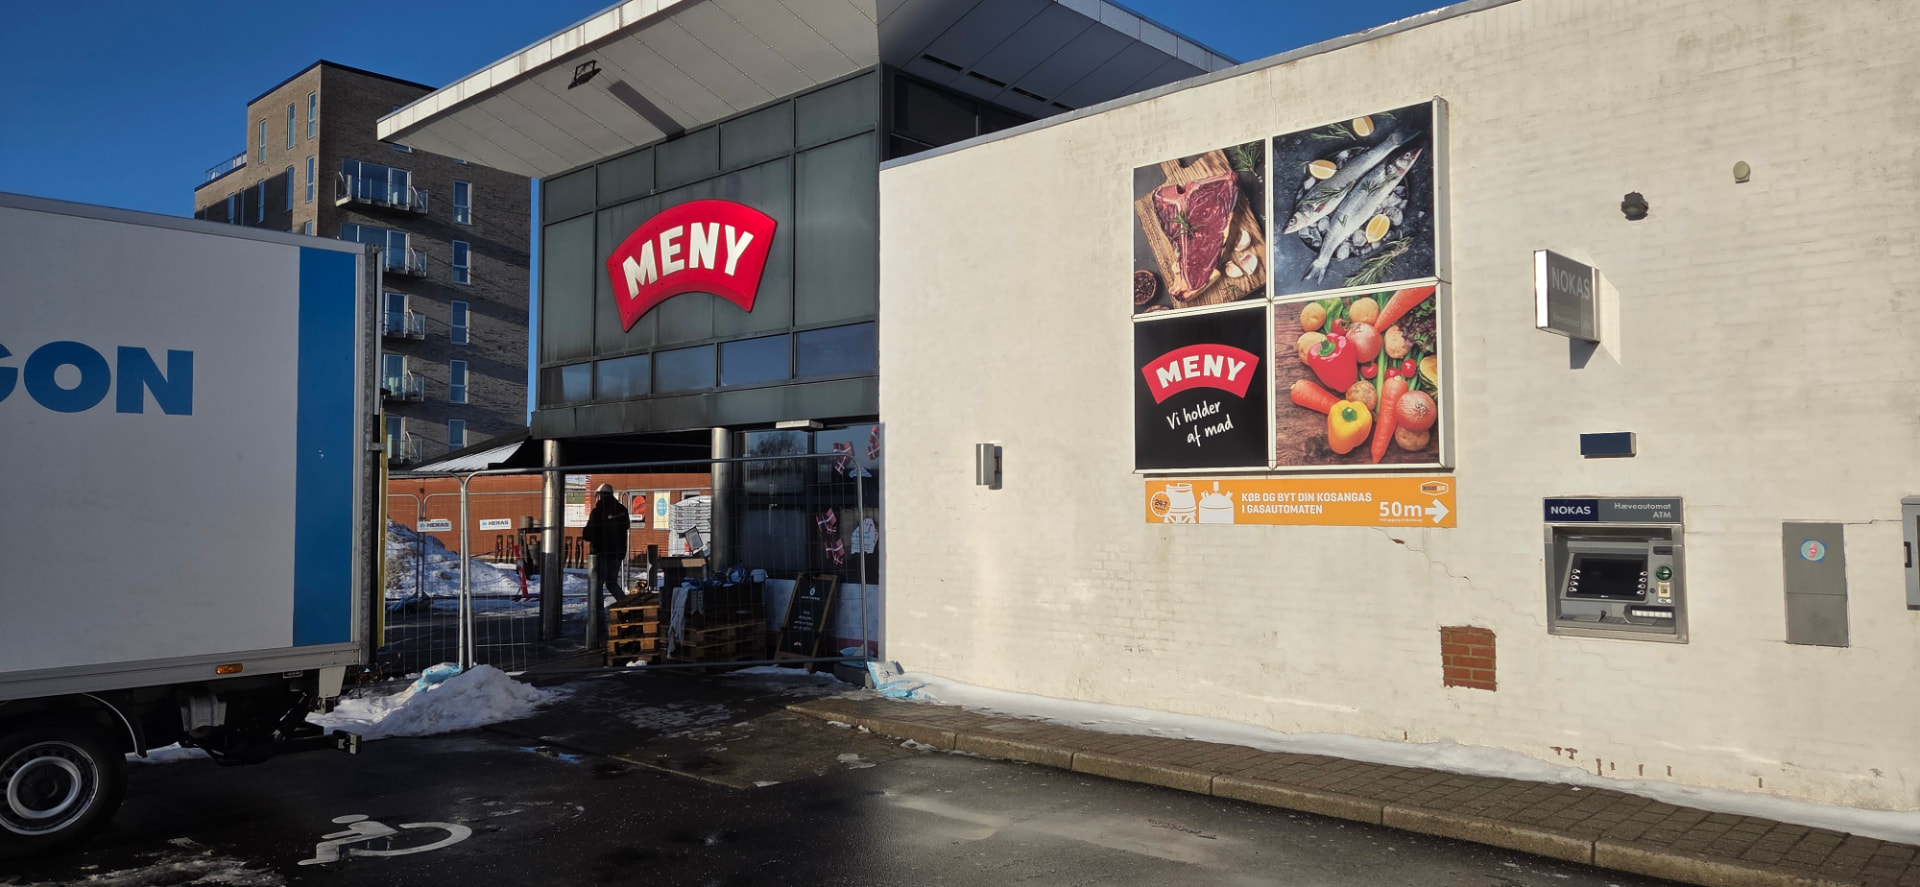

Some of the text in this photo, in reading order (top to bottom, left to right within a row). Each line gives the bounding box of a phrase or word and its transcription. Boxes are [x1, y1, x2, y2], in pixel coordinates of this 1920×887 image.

[622, 222, 754, 300] MENY
[1551, 266, 1591, 300] NOKAS
[1155, 354, 1246, 389] MENY
[1166, 400, 1221, 430] Vi holder
[1187, 414, 1234, 448] af mad
[1241, 492, 1373, 502] KØB OG BYT DIN KOSANGAS
[1614, 502, 1671, 510] Hæveautomat
[1246, 504, 1323, 514] GASAUTOMATEN
[1550, 505, 1591, 515] NOKAS
[1653, 511, 1671, 519] ATM
